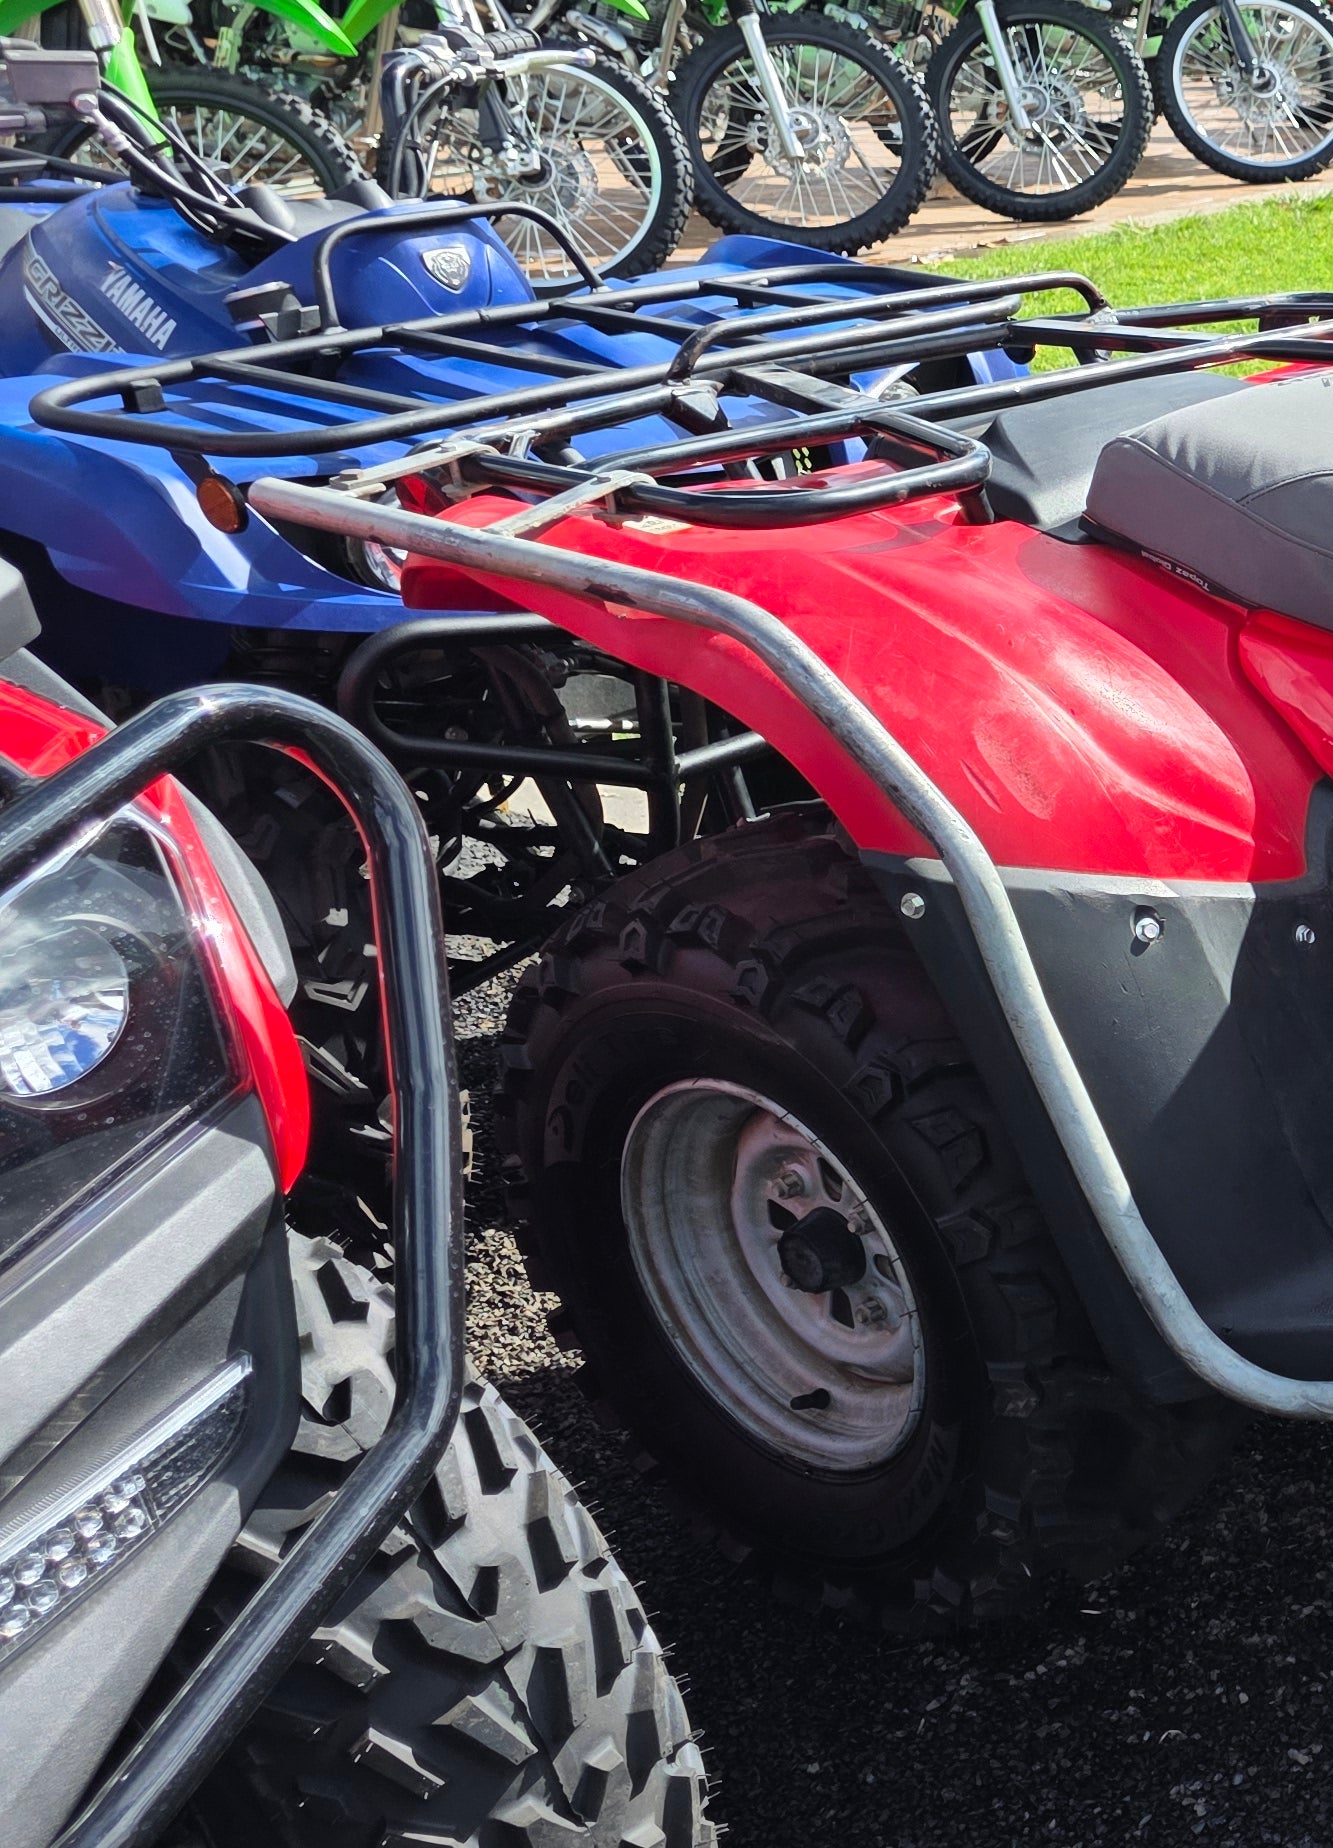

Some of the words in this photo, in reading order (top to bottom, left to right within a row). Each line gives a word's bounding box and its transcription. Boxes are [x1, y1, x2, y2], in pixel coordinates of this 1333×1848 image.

[101, 262, 177, 351] YAMAHA
[1141, 550, 1172, 571] Global
[1175, 566, 1210, 592] Topaz
